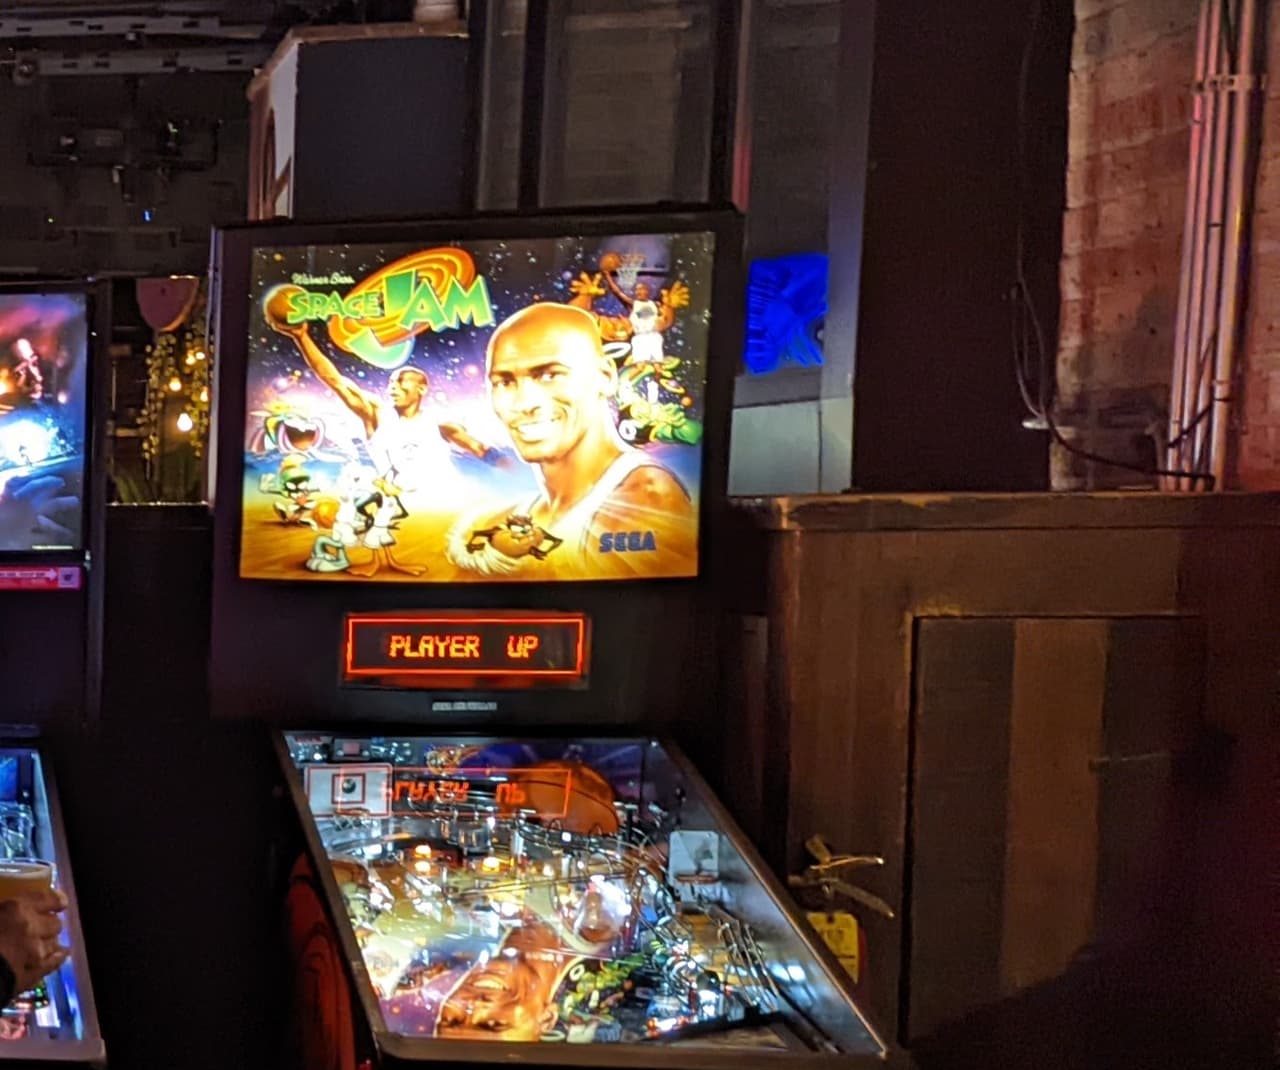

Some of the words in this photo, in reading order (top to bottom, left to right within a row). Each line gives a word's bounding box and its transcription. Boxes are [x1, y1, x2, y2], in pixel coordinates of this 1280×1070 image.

[287, 291, 382, 324] SPACE
[344, 269, 496, 370] JAM
[599, 530, 657, 553] SEGA
[390, 635, 480, 658] PLAYER
[507, 635, 540, 658] UP
